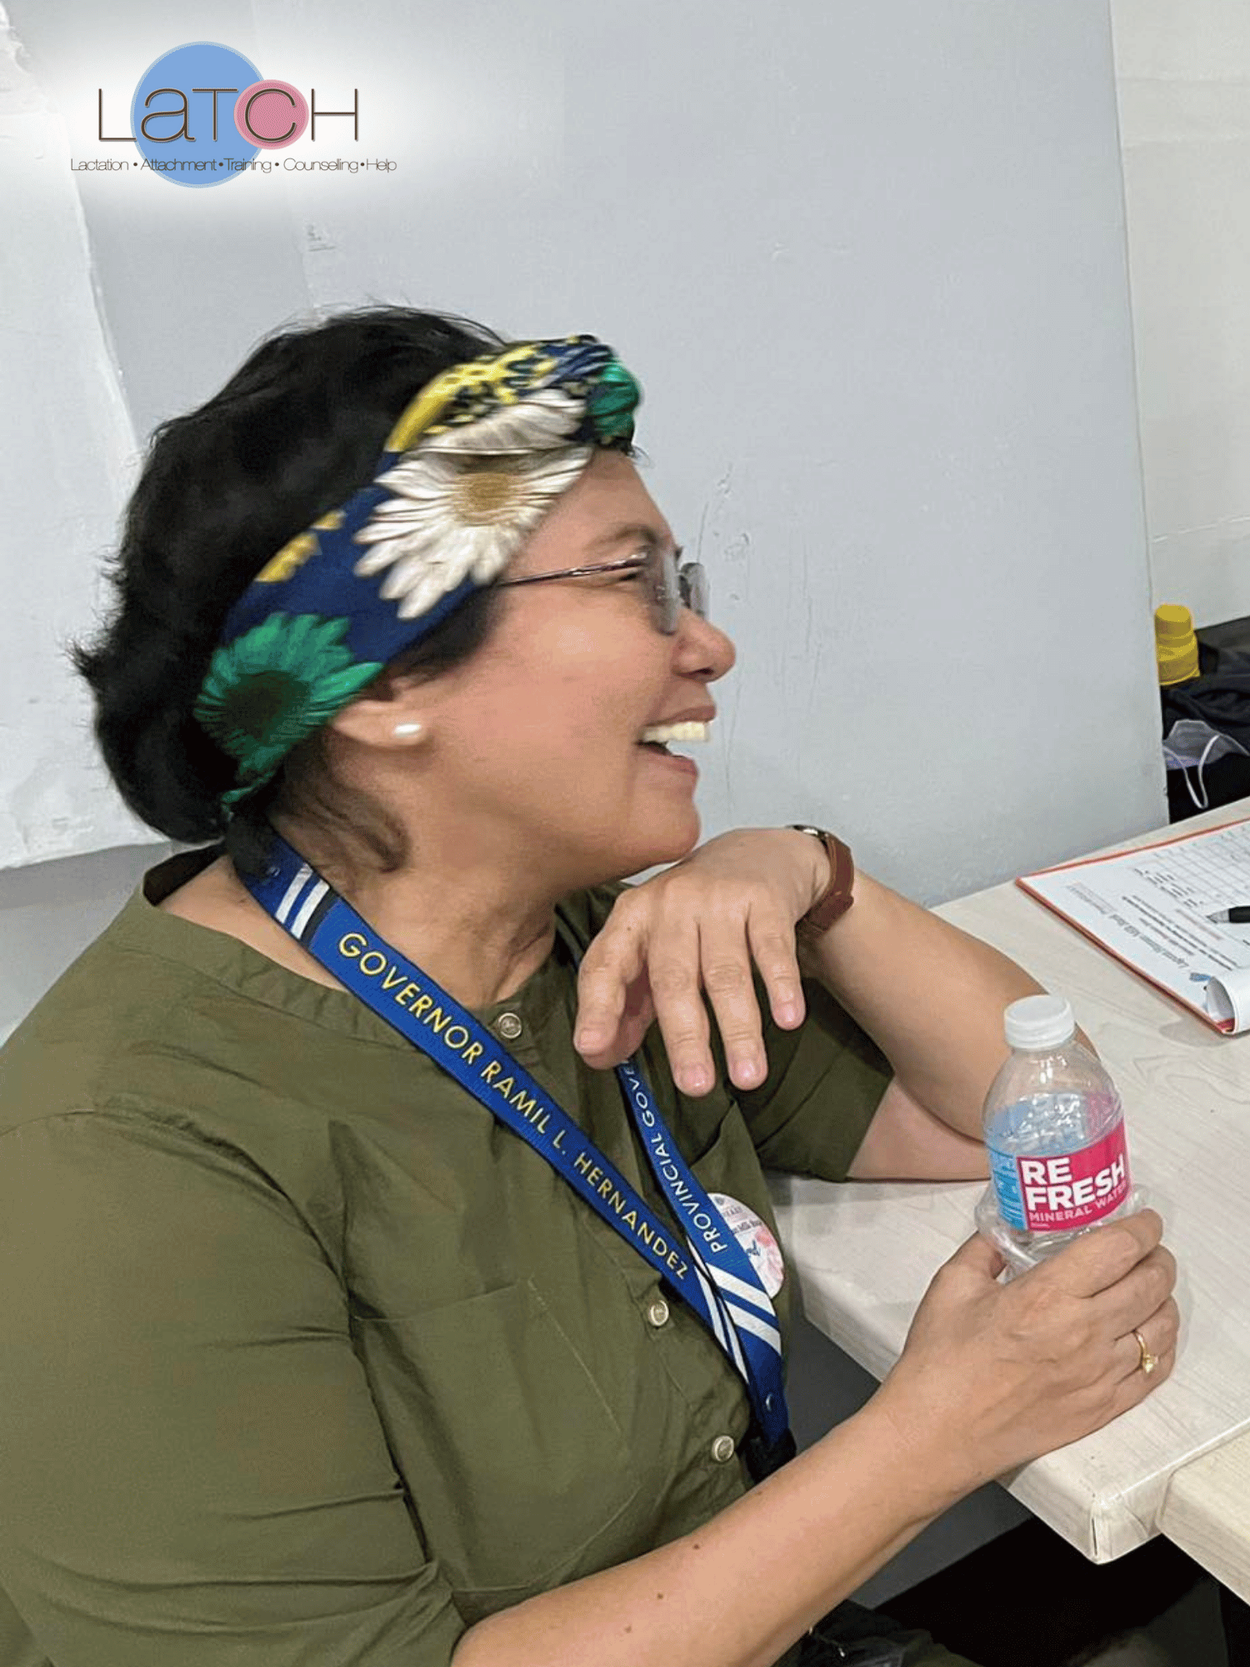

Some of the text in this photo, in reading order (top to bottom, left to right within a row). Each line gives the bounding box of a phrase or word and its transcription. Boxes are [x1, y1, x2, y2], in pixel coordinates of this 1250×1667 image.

[338, 932, 690, 1280] GOVERNOR RAMIL L. HERNANDEZ
[624, 1064, 728, 1253] PROVINCIAL GOVE
[1020, 1157, 1072, 1185] RE
[1025, 1153, 1125, 1211] FRESH
[1028, 1206, 1093, 1222] MINERAL
